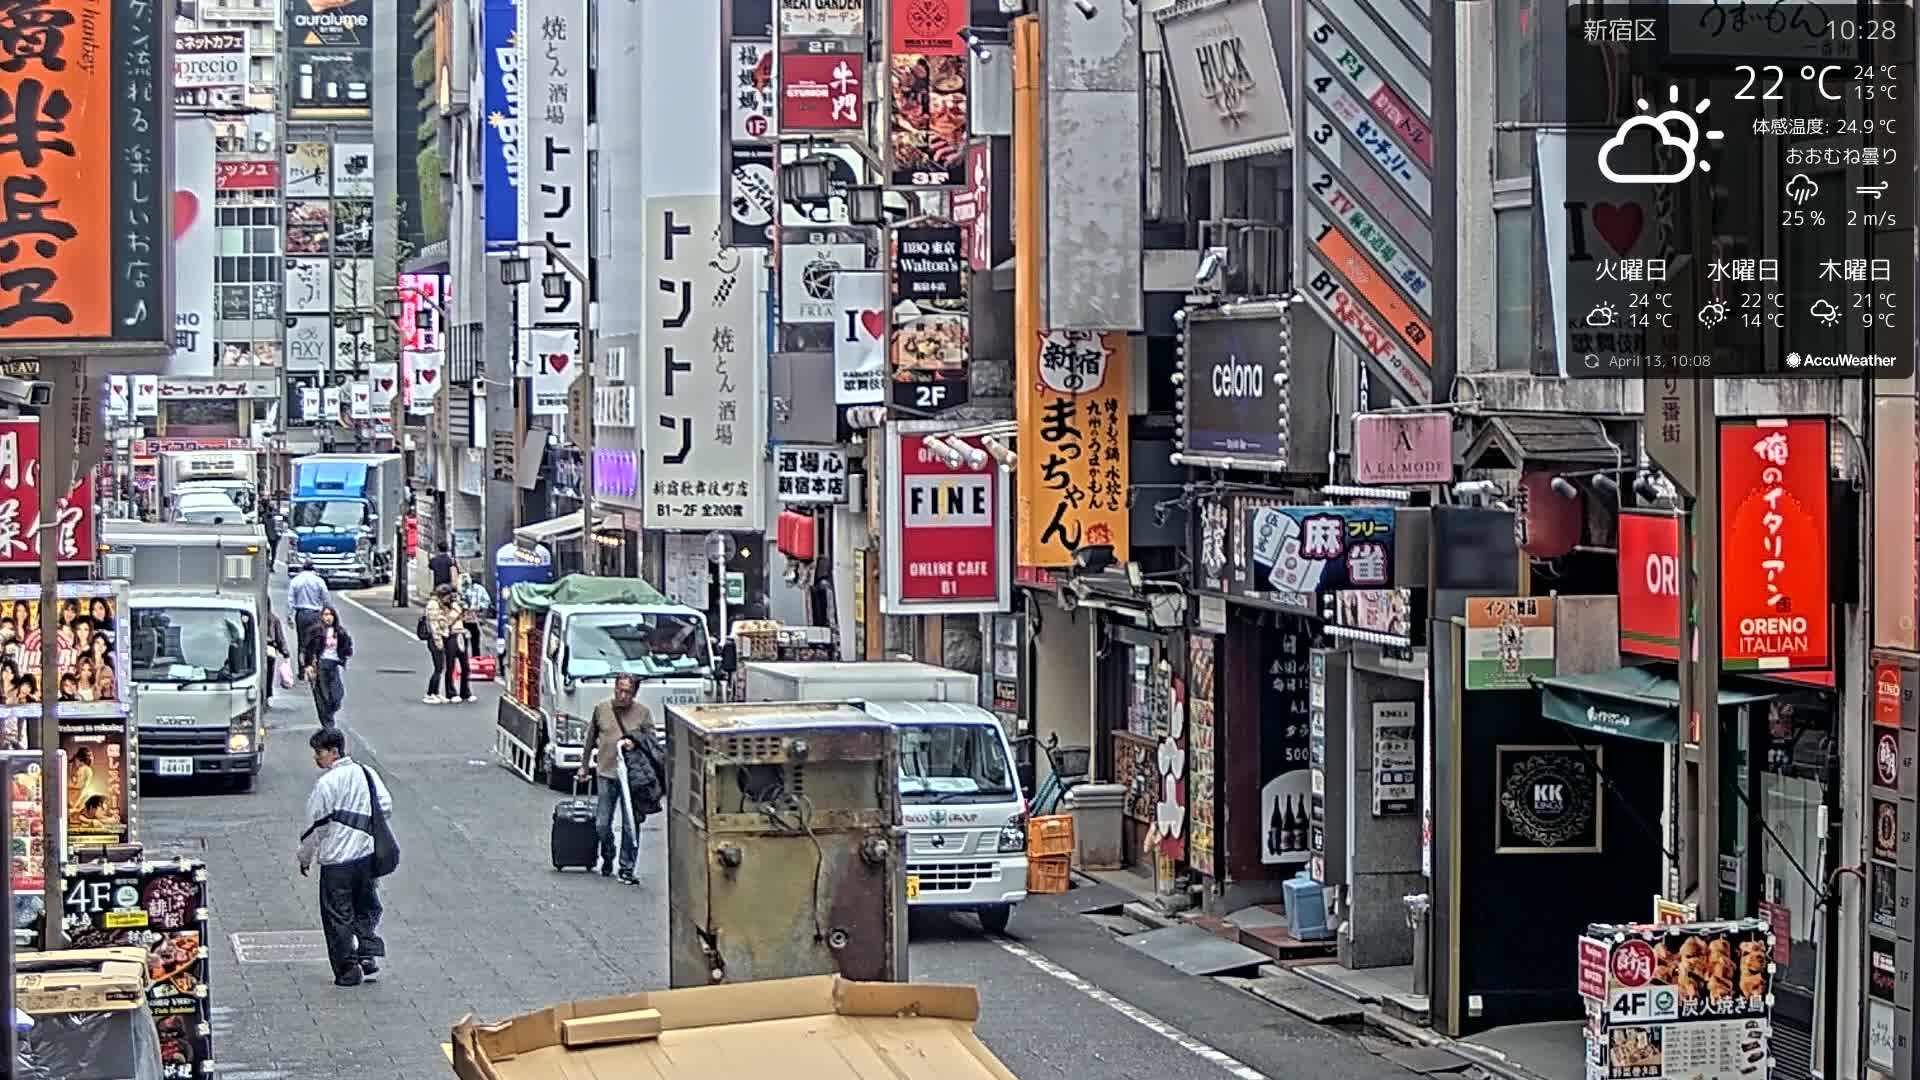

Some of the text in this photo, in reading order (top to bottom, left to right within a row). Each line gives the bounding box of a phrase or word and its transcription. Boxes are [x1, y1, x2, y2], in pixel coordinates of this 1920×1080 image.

[295, 12, 368, 26] auralume
[1313, 24, 1334, 43] 5
[830, 61, 858, 121] 牛門
[749, 122, 767, 136] 1F
[1313, 124, 1333, 144] 3
[1312, 174, 1333, 194] 2
[899, 257, 958, 273] Walton's
[1311, 270, 1335, 300] B1
[844, 310, 859, 342] I
[659, 211, 691, 464] トントン
[539, 354, 548, 375] I
[711, 326, 737, 446] 焼とん 酒場
[844, 380, 884, 391] 歌舞伎
[916, 386, 946, 406] 2F
[779, 453, 843, 473] 酒場心
[1040, 398, 1086, 551] まっちゃん
[779, 477, 843, 495] 新宿本店
[911, 487, 986, 515] FINE
[1349, 521, 1389, 537] フリー
[1753, 432, 1789, 607] 俺のイタリアン
[957, 562, 988, 576] CAFE
[1740, 617, 1807, 635] ORENO
[1739, 636, 1808, 654] ITALIAN
[1534, 784, 1563, 800] KK
[67, 880, 111, 912] 4F
[1613, 993, 1647, 1016] 4F
